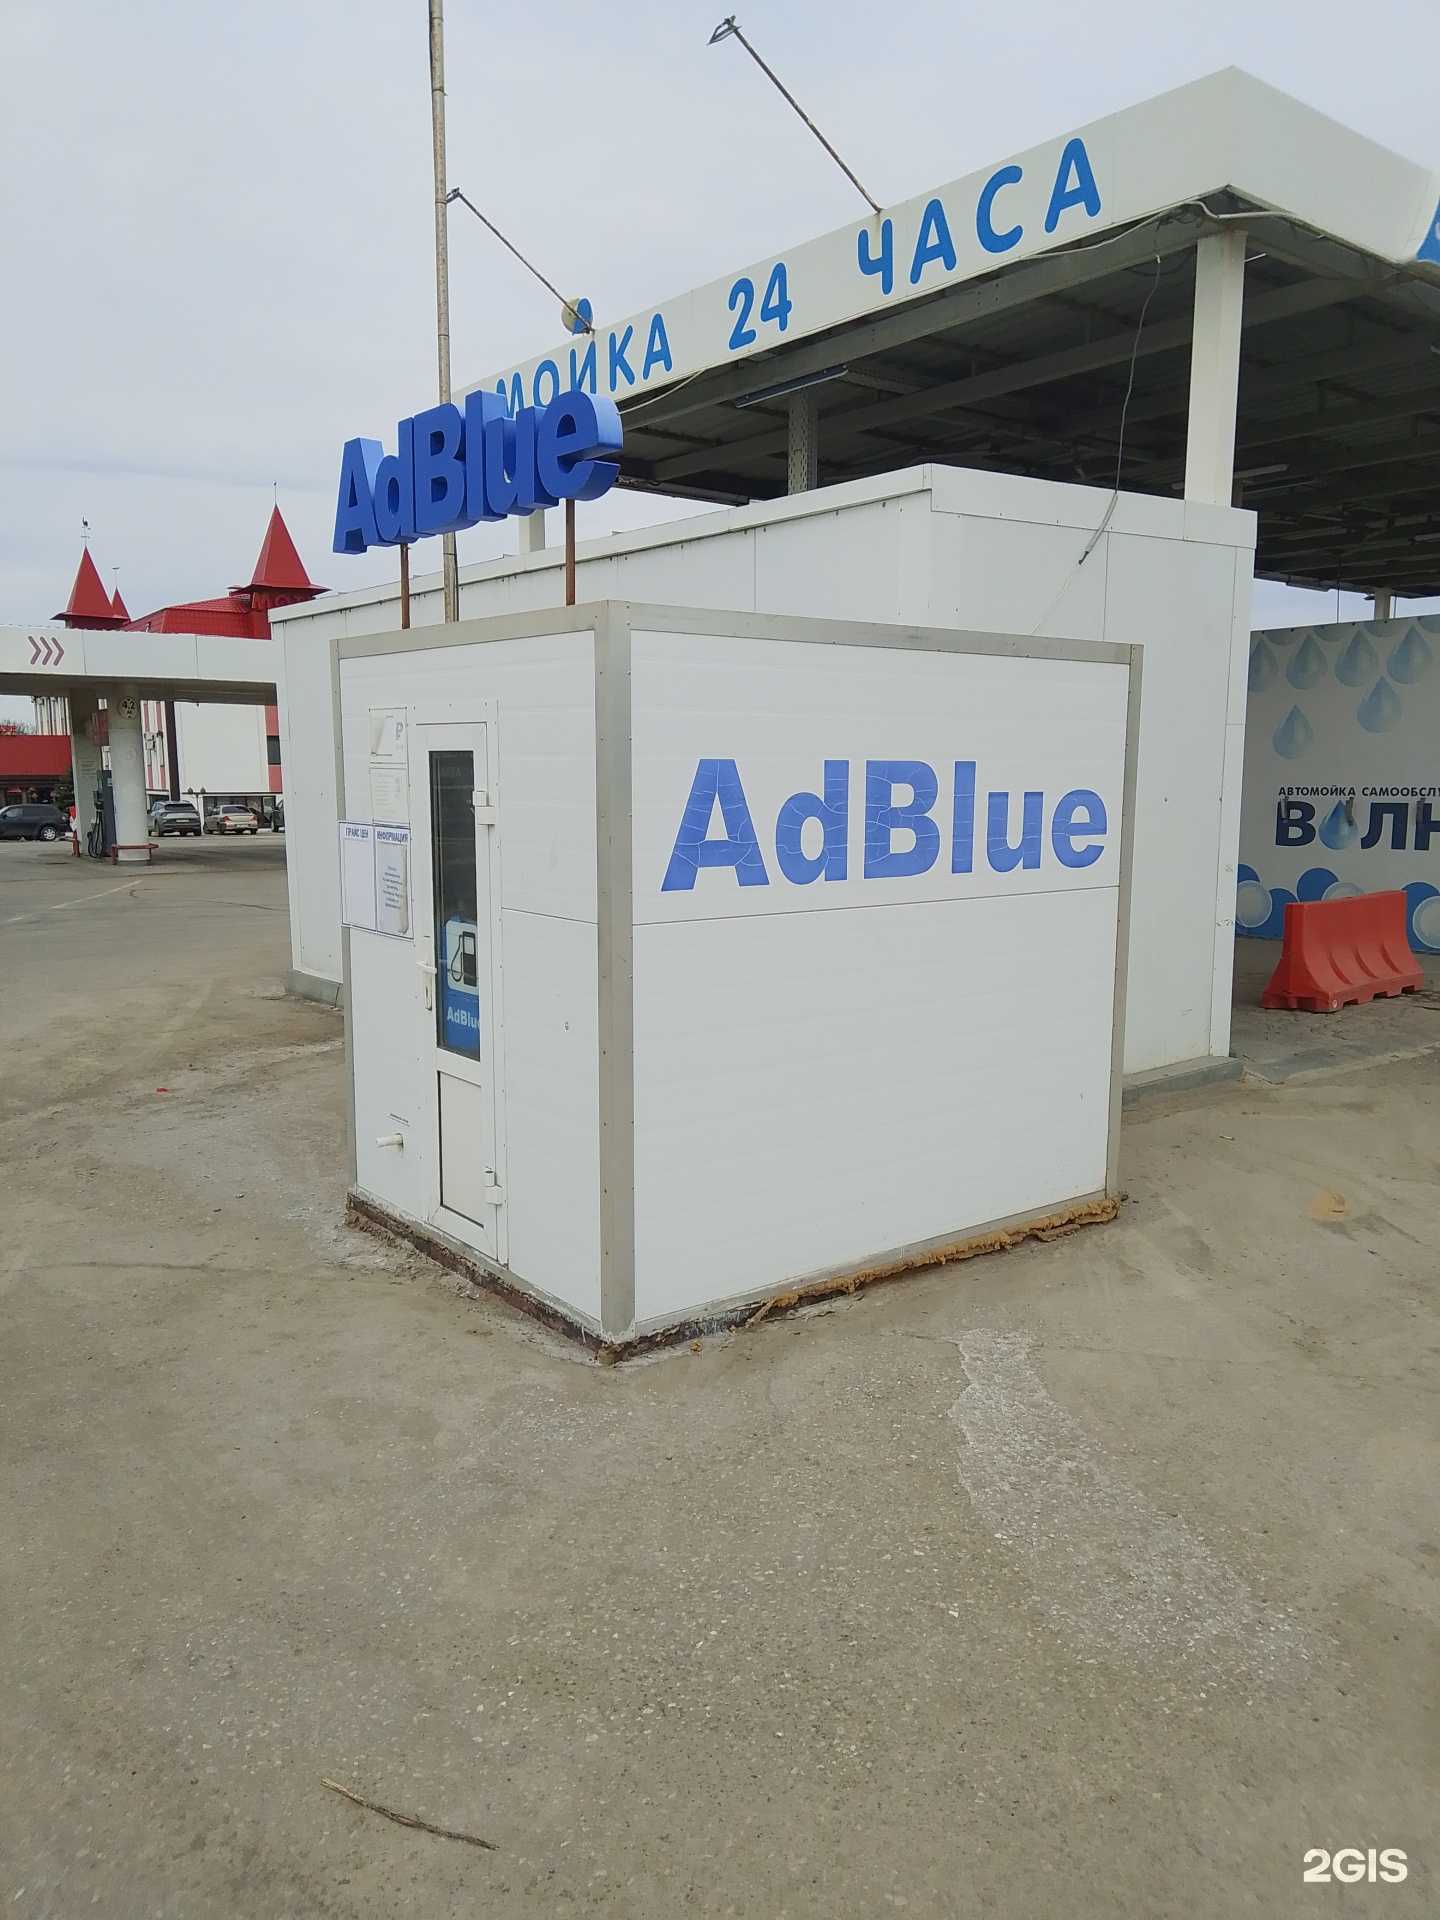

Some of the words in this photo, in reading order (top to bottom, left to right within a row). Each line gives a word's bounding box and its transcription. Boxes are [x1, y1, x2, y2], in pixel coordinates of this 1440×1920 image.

[728, 262, 792, 350] 24
[858, 138, 1101, 296] ЧАСА
[333, 389, 623, 554] AdBlue
[661, 758, 1108, 892] AdBlue
[1278, 785, 1356, 797] АВТОМОЙКА
[1362, 786, 1440, 797] САМООБСЛ
[376, 830, 408, 842] ИНФОРМАЦИЯ
[447, 1006, 480, 1028] AdBlu
